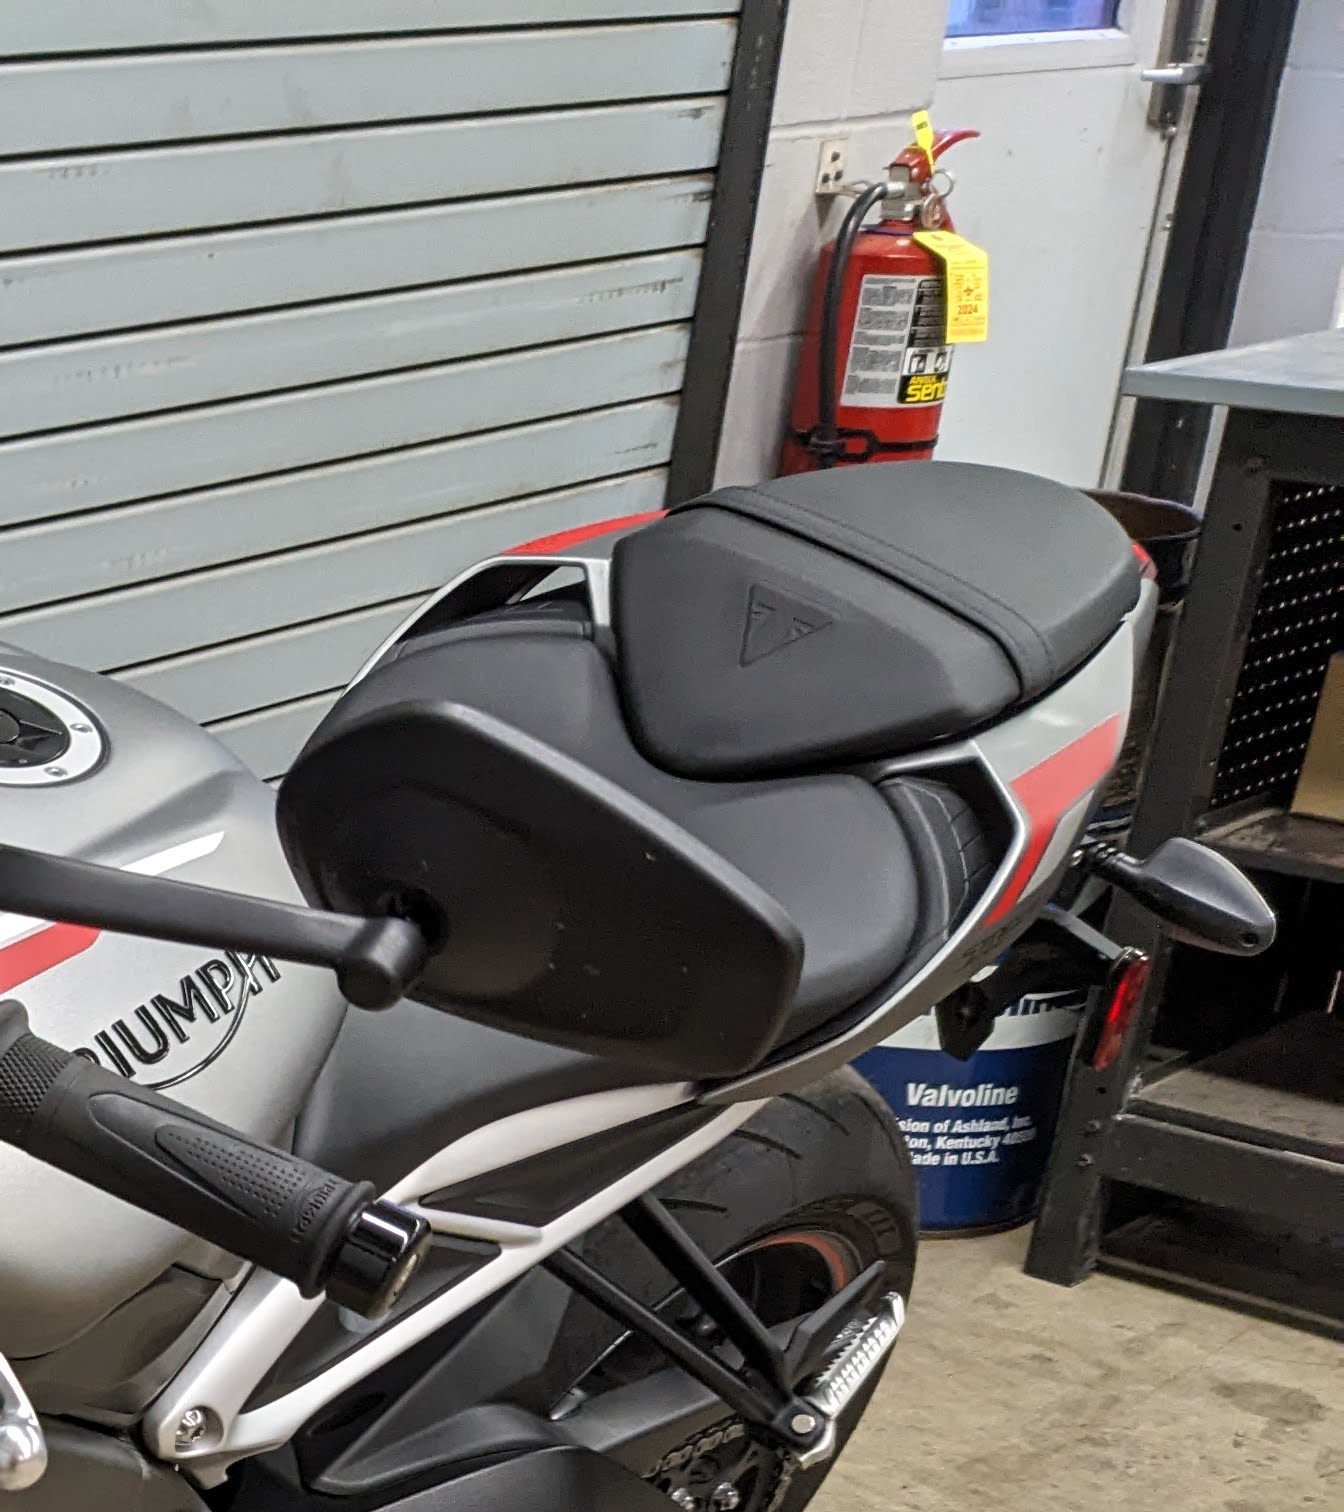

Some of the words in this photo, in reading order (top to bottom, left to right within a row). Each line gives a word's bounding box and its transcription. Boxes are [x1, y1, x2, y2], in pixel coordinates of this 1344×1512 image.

[72, 950, 282, 1078] IUMPH
[907, 1083, 1019, 1107] Valvoline
[933, 1119, 950, 1133] of
[935, 1135, 1001, 1149] Kentucky
[944, 1152, 958, 1164] in
